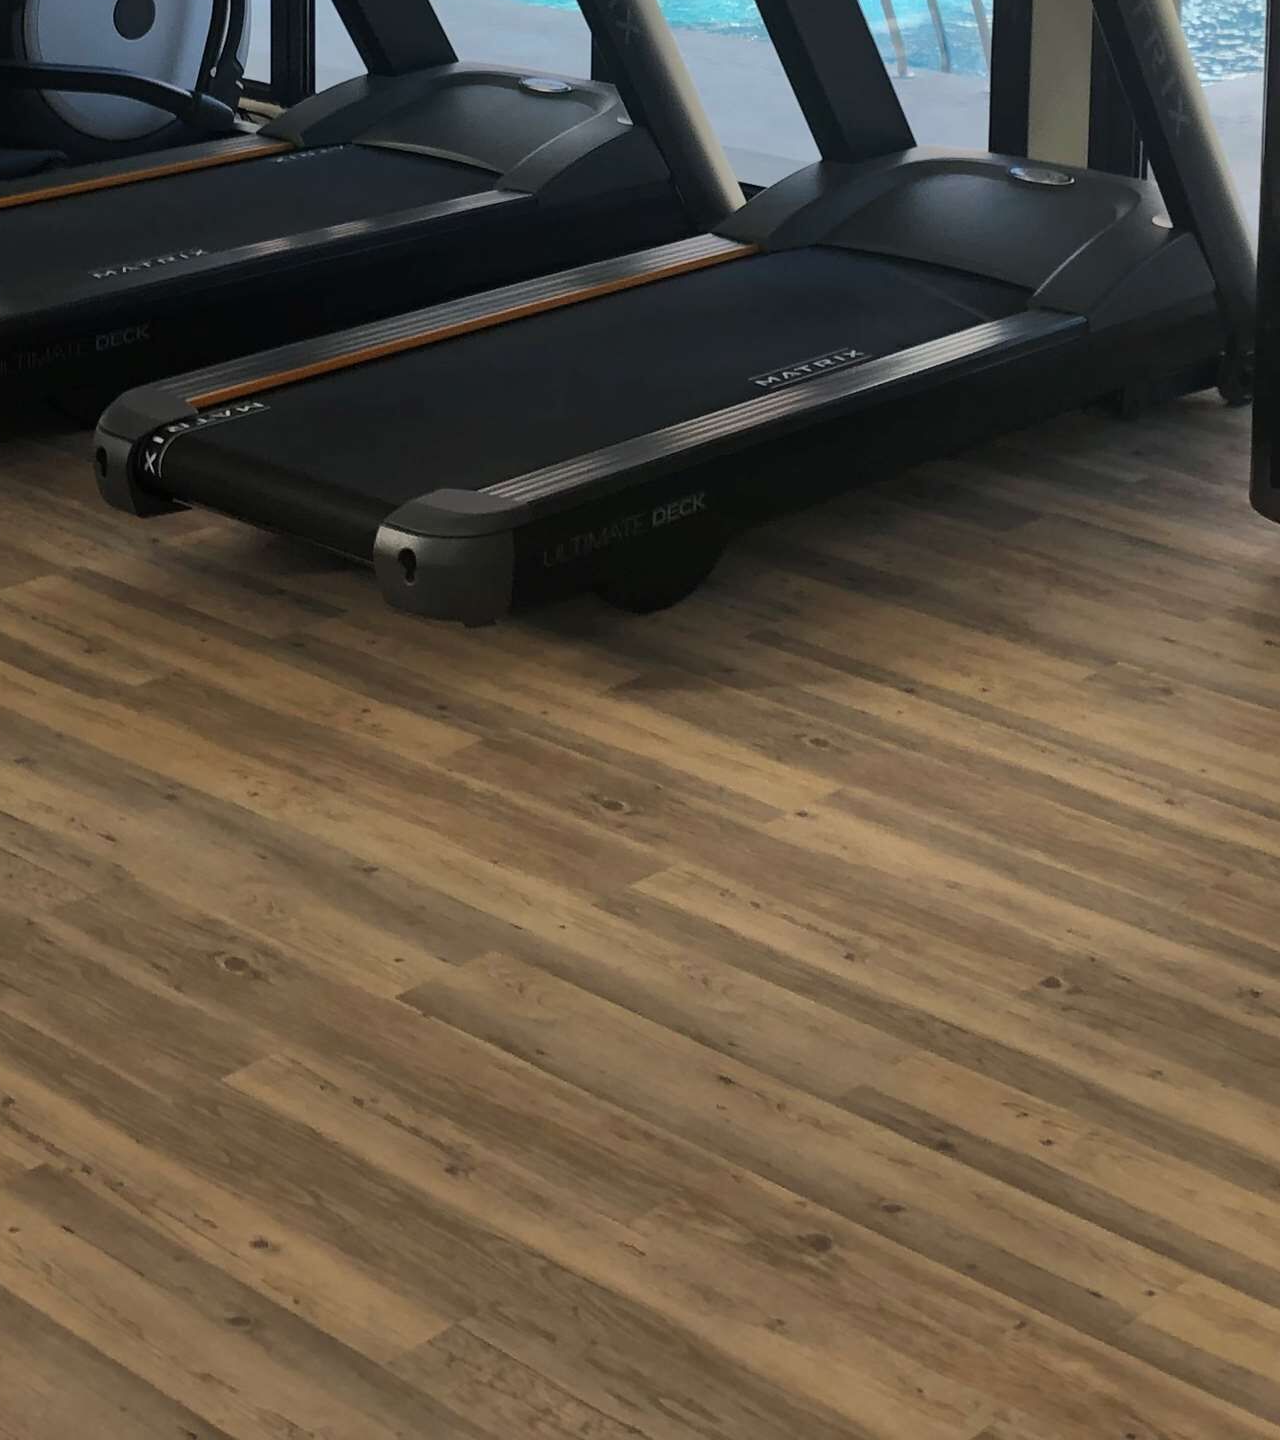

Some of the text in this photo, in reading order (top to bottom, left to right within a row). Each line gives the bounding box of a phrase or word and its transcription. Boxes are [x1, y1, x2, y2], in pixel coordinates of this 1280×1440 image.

[95, 320, 152, 352] DECK
[753, 349, 865, 387] MATRIX
[651, 491, 707, 528] DECK
